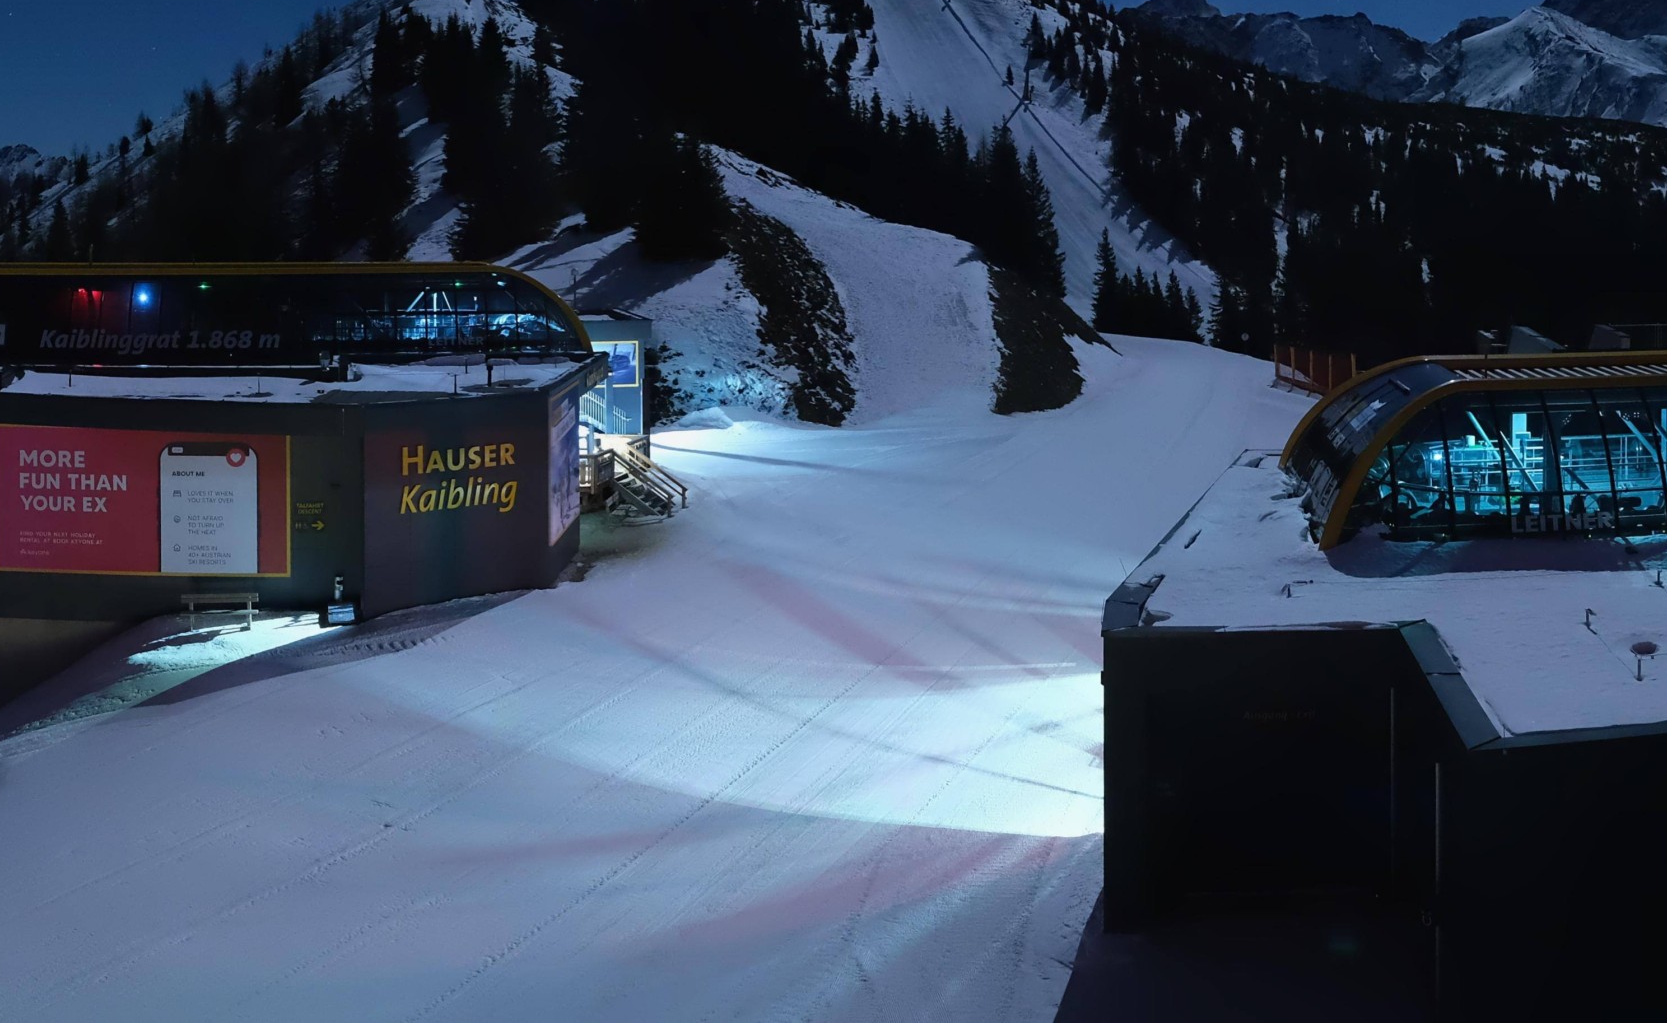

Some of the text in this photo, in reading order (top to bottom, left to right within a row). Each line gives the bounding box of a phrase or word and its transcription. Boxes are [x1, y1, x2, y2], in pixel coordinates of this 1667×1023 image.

[39, 328, 281, 356] Kaiblinggrat 1.868 m
[18, 449, 86, 468] MORE
[401, 442, 516, 477] HAUSER
[18, 472, 128, 492] FUN THAN
[20, 495, 108, 513] YOUR EX
[399, 477, 519, 515] Kaibling
[1511, 511, 1613, 534] LEITNER
